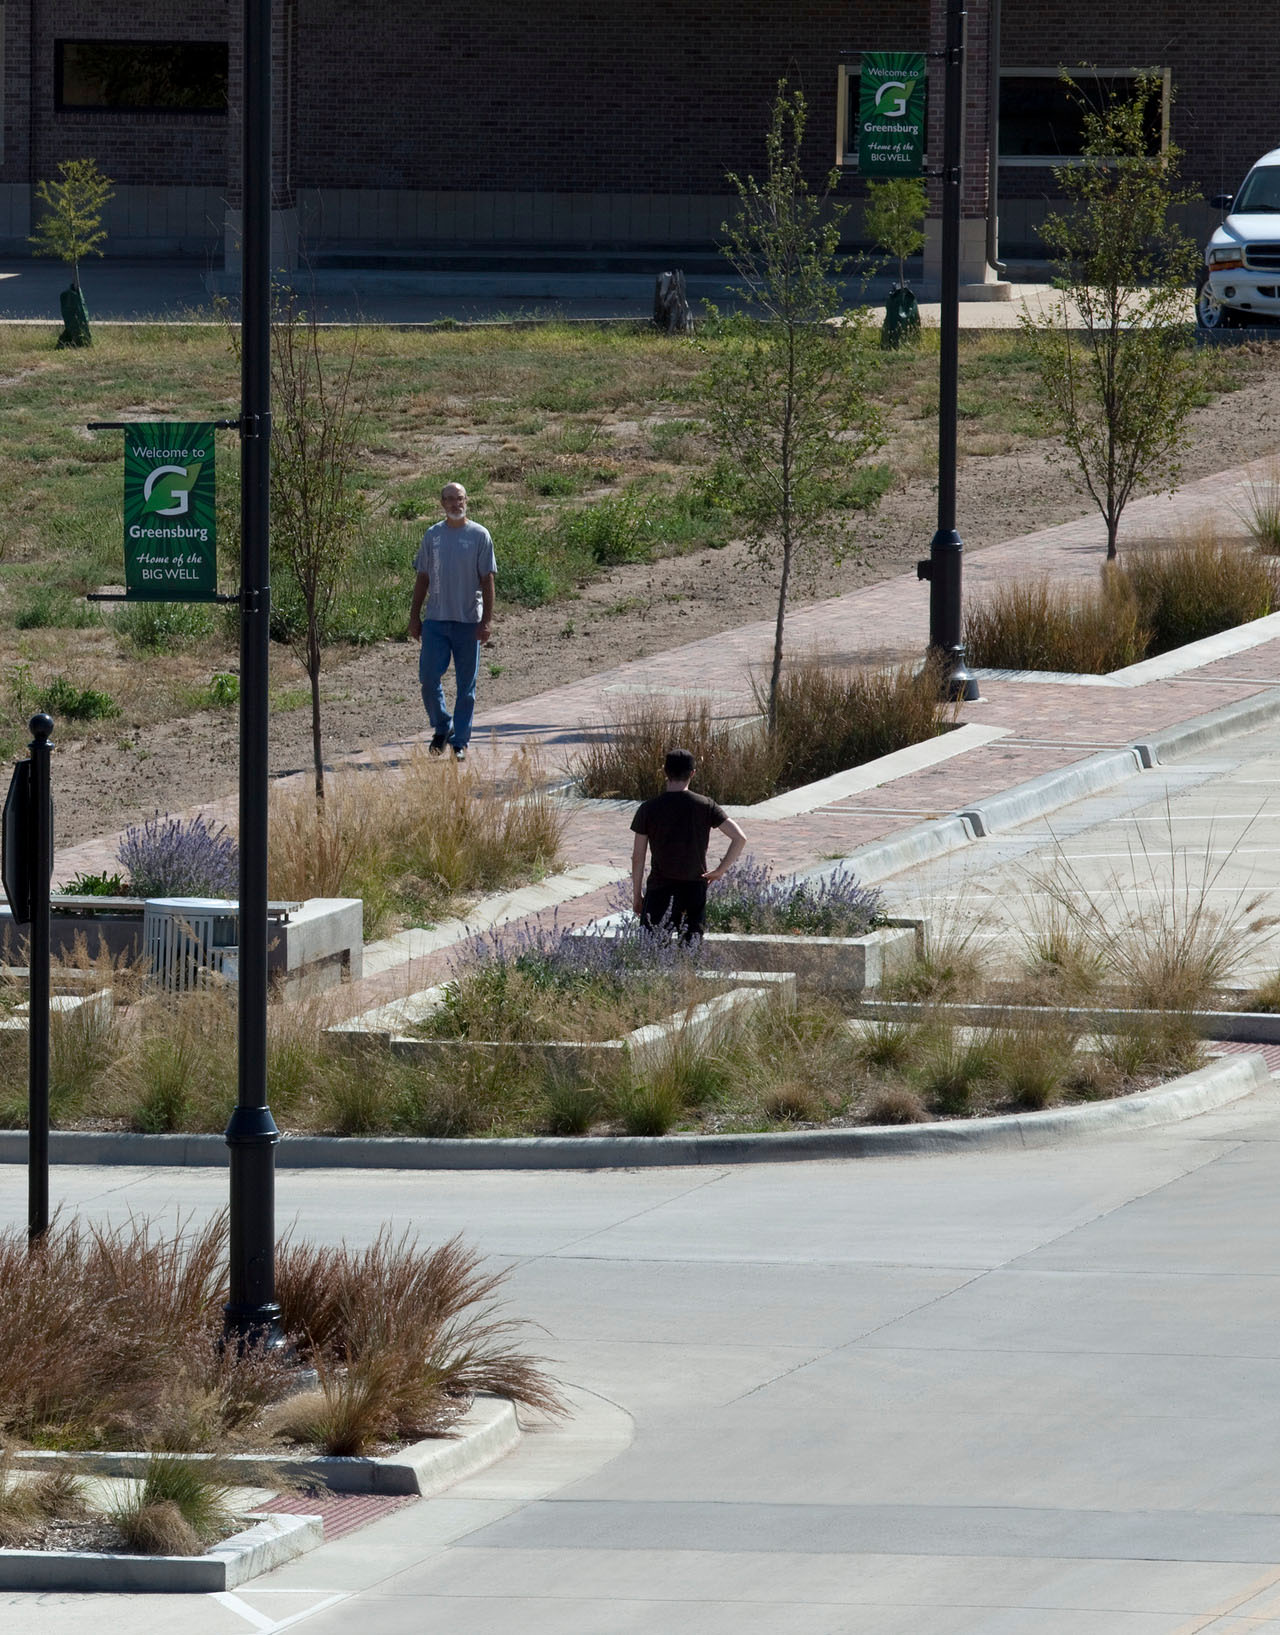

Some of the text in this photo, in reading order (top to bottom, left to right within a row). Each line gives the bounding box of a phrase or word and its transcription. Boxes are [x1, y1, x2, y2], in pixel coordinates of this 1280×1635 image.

[868, 68, 919, 77] Welcome to
[875, 81, 906, 117] G
[864, 122, 919, 135] Greensburg
[868, 142, 914, 153] Home of the
[871, 154, 911, 162] BIG WELL
[132, 446, 205, 458] Welcome to
[144, 465, 189, 516] G
[129, 525, 208, 541] Greensburg
[136, 552, 202, 567] Home of the
[142, 569, 200, 580] BIG WELL
